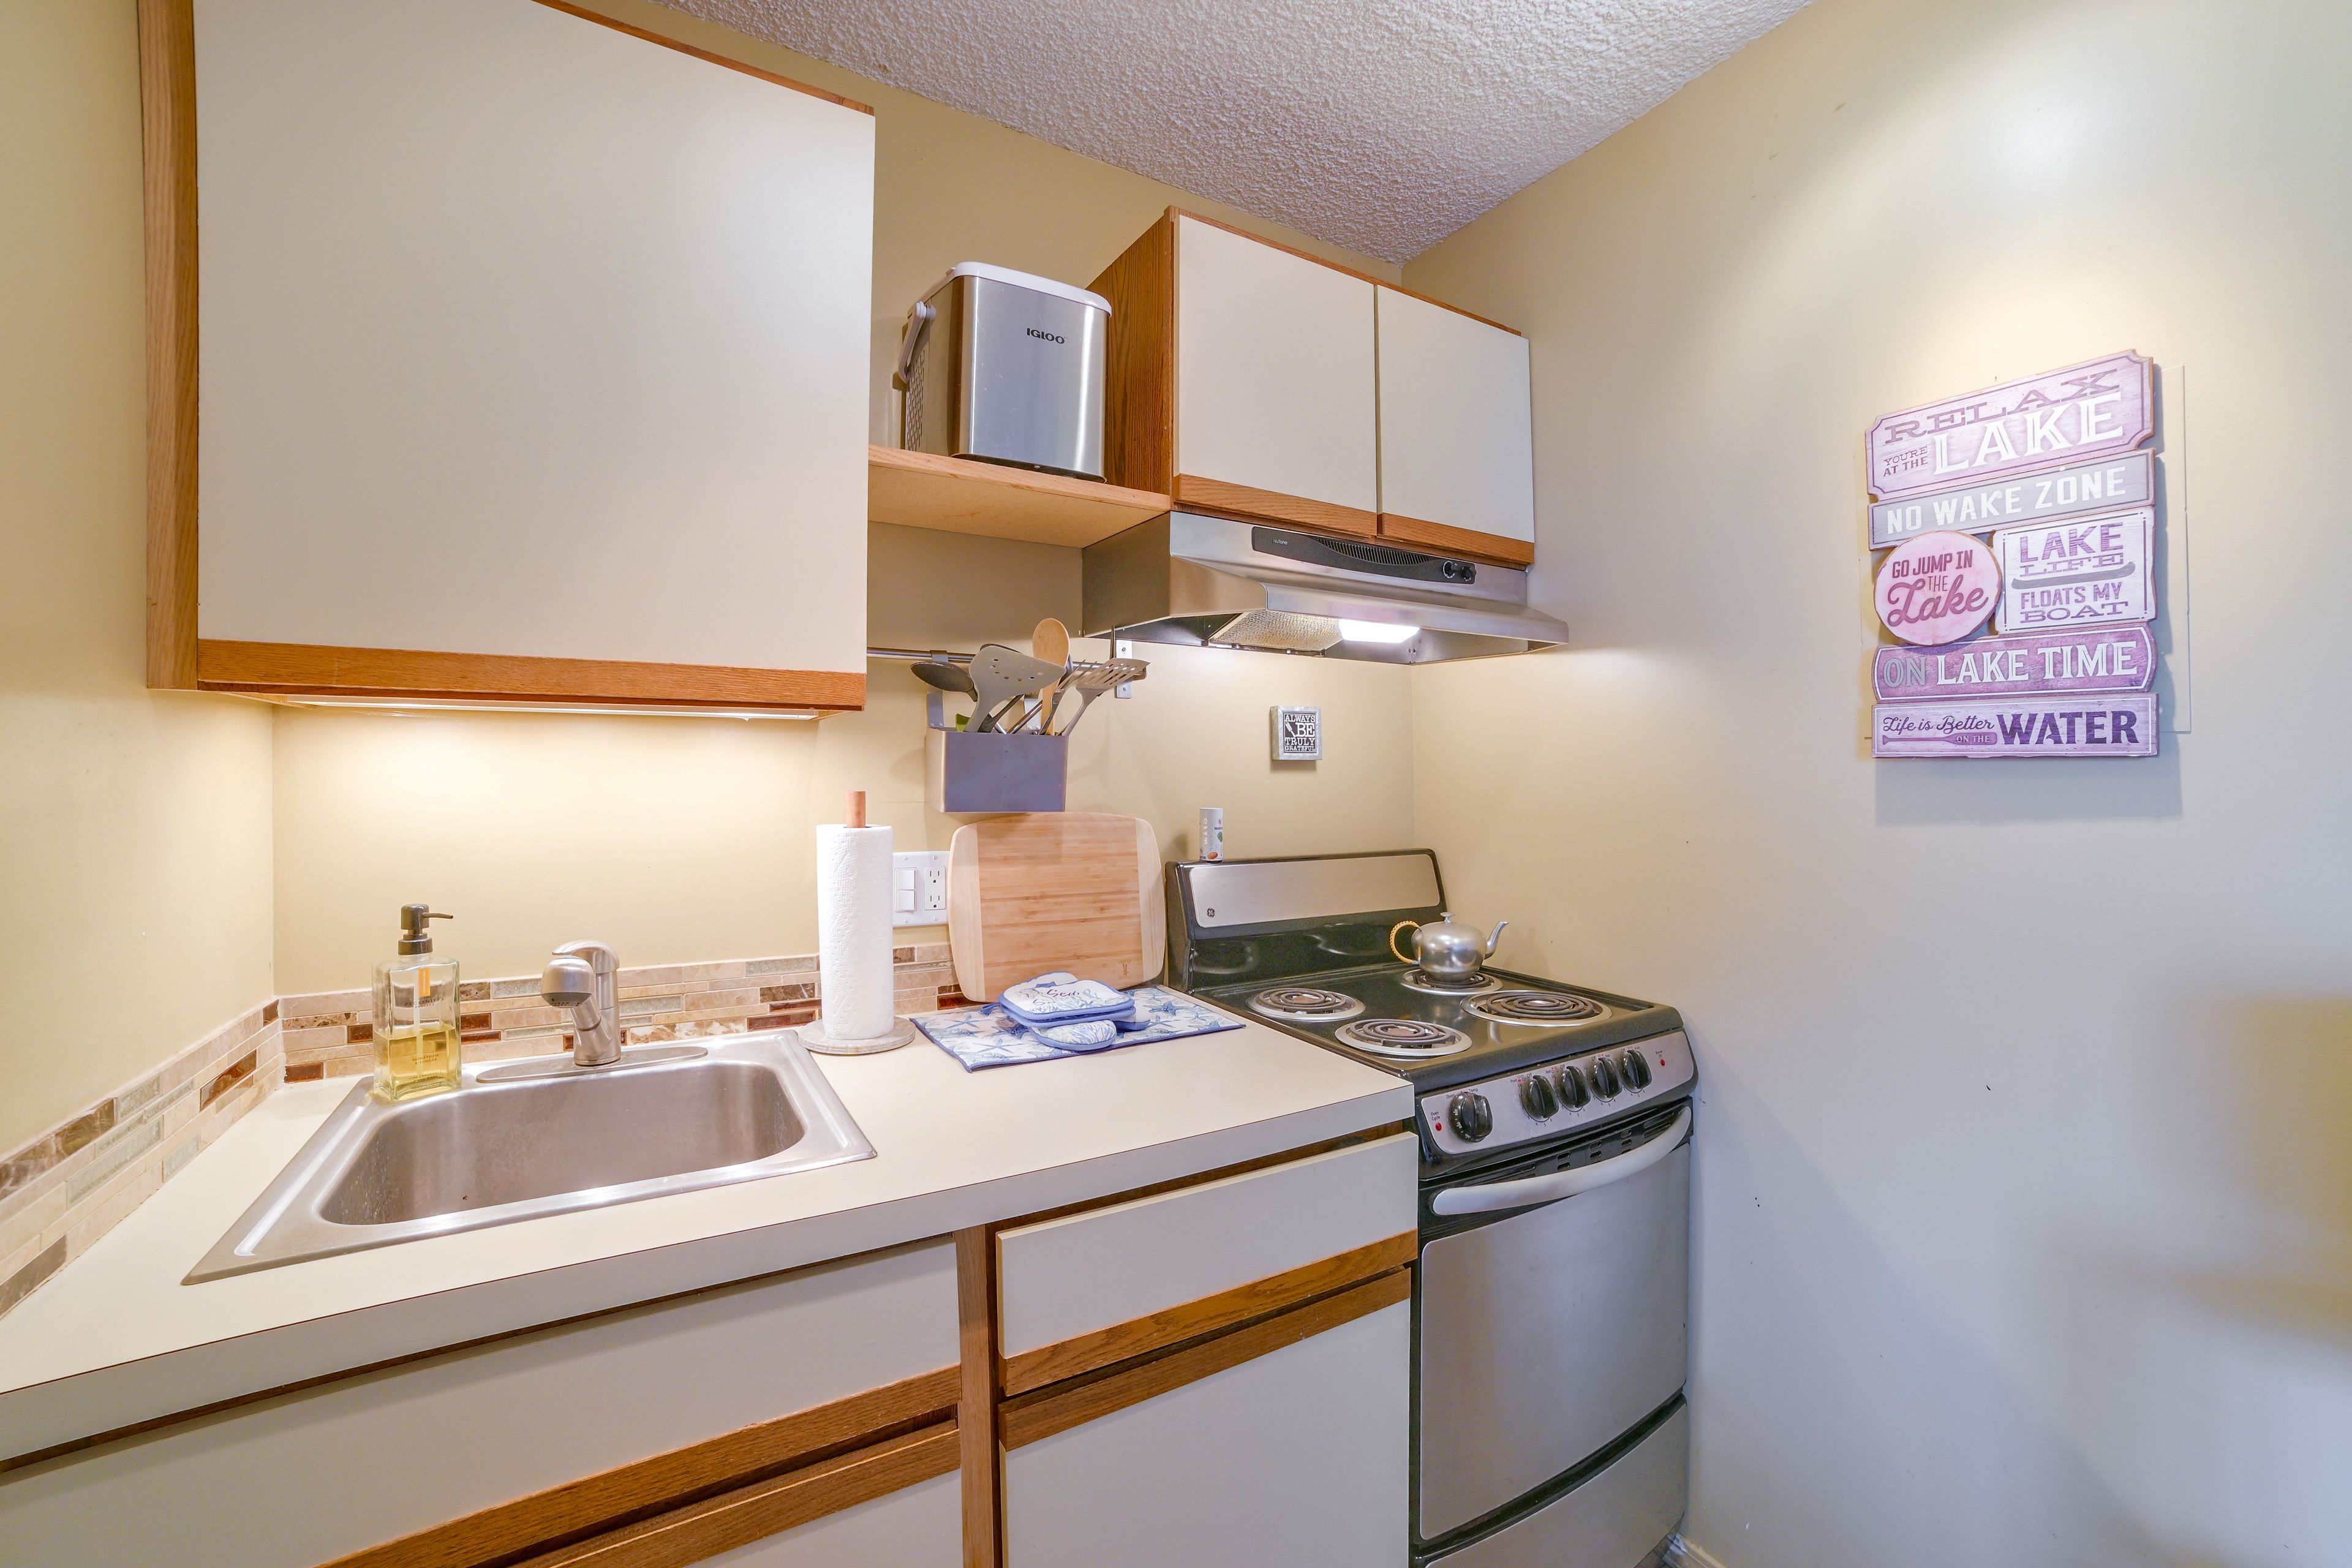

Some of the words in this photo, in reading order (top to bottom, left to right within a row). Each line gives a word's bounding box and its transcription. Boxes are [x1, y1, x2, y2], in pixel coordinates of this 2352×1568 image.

[1027, 328, 1065, 344] IGLOO
[1885, 369, 2120, 443] RELAX
[1931, 391, 2124, 475] LAKE
[1883, 446, 1928, 466] YOU'RE
[1883, 465, 1898, 477] AT
[1902, 456, 1928, 470] THE
[1887, 504, 1921, 534] NO
[1933, 486, 2022, 526] WAKE
[2035, 466, 2127, 509] ZONE
[2019, 522, 2124, 563] LAKE
[1892, 559, 1910, 579] GO
[1912, 554, 1953, 576] JUMP
[1956, 549, 1973, 568] IN
[2019, 552, 2124, 577] LIFE
[1927, 575, 1948, 592] THE
[2021, 586, 2087, 609] FLOATS
[2093, 581, 2122, 601] MY
[1887, 574, 1989, 627] Lake
[2019, 601, 2128, 623] BOAT
[1883, 657, 1926, 688] ON
[1936, 647, 2029, 686] LAKE
[2037, 641, 2137, 679] TIME
[1284, 714, 1316, 723] ALWAYS
[1295, 722, 1315, 737] BE
[1883, 715, 1917, 732] Life
[1918, 717, 1934, 731] is
[1936, 715, 1996, 731] Better
[1996, 710, 2139, 745] WATER
[1284, 737, 1316, 745] TRULY
[1971, 734, 1990, 743] THE
